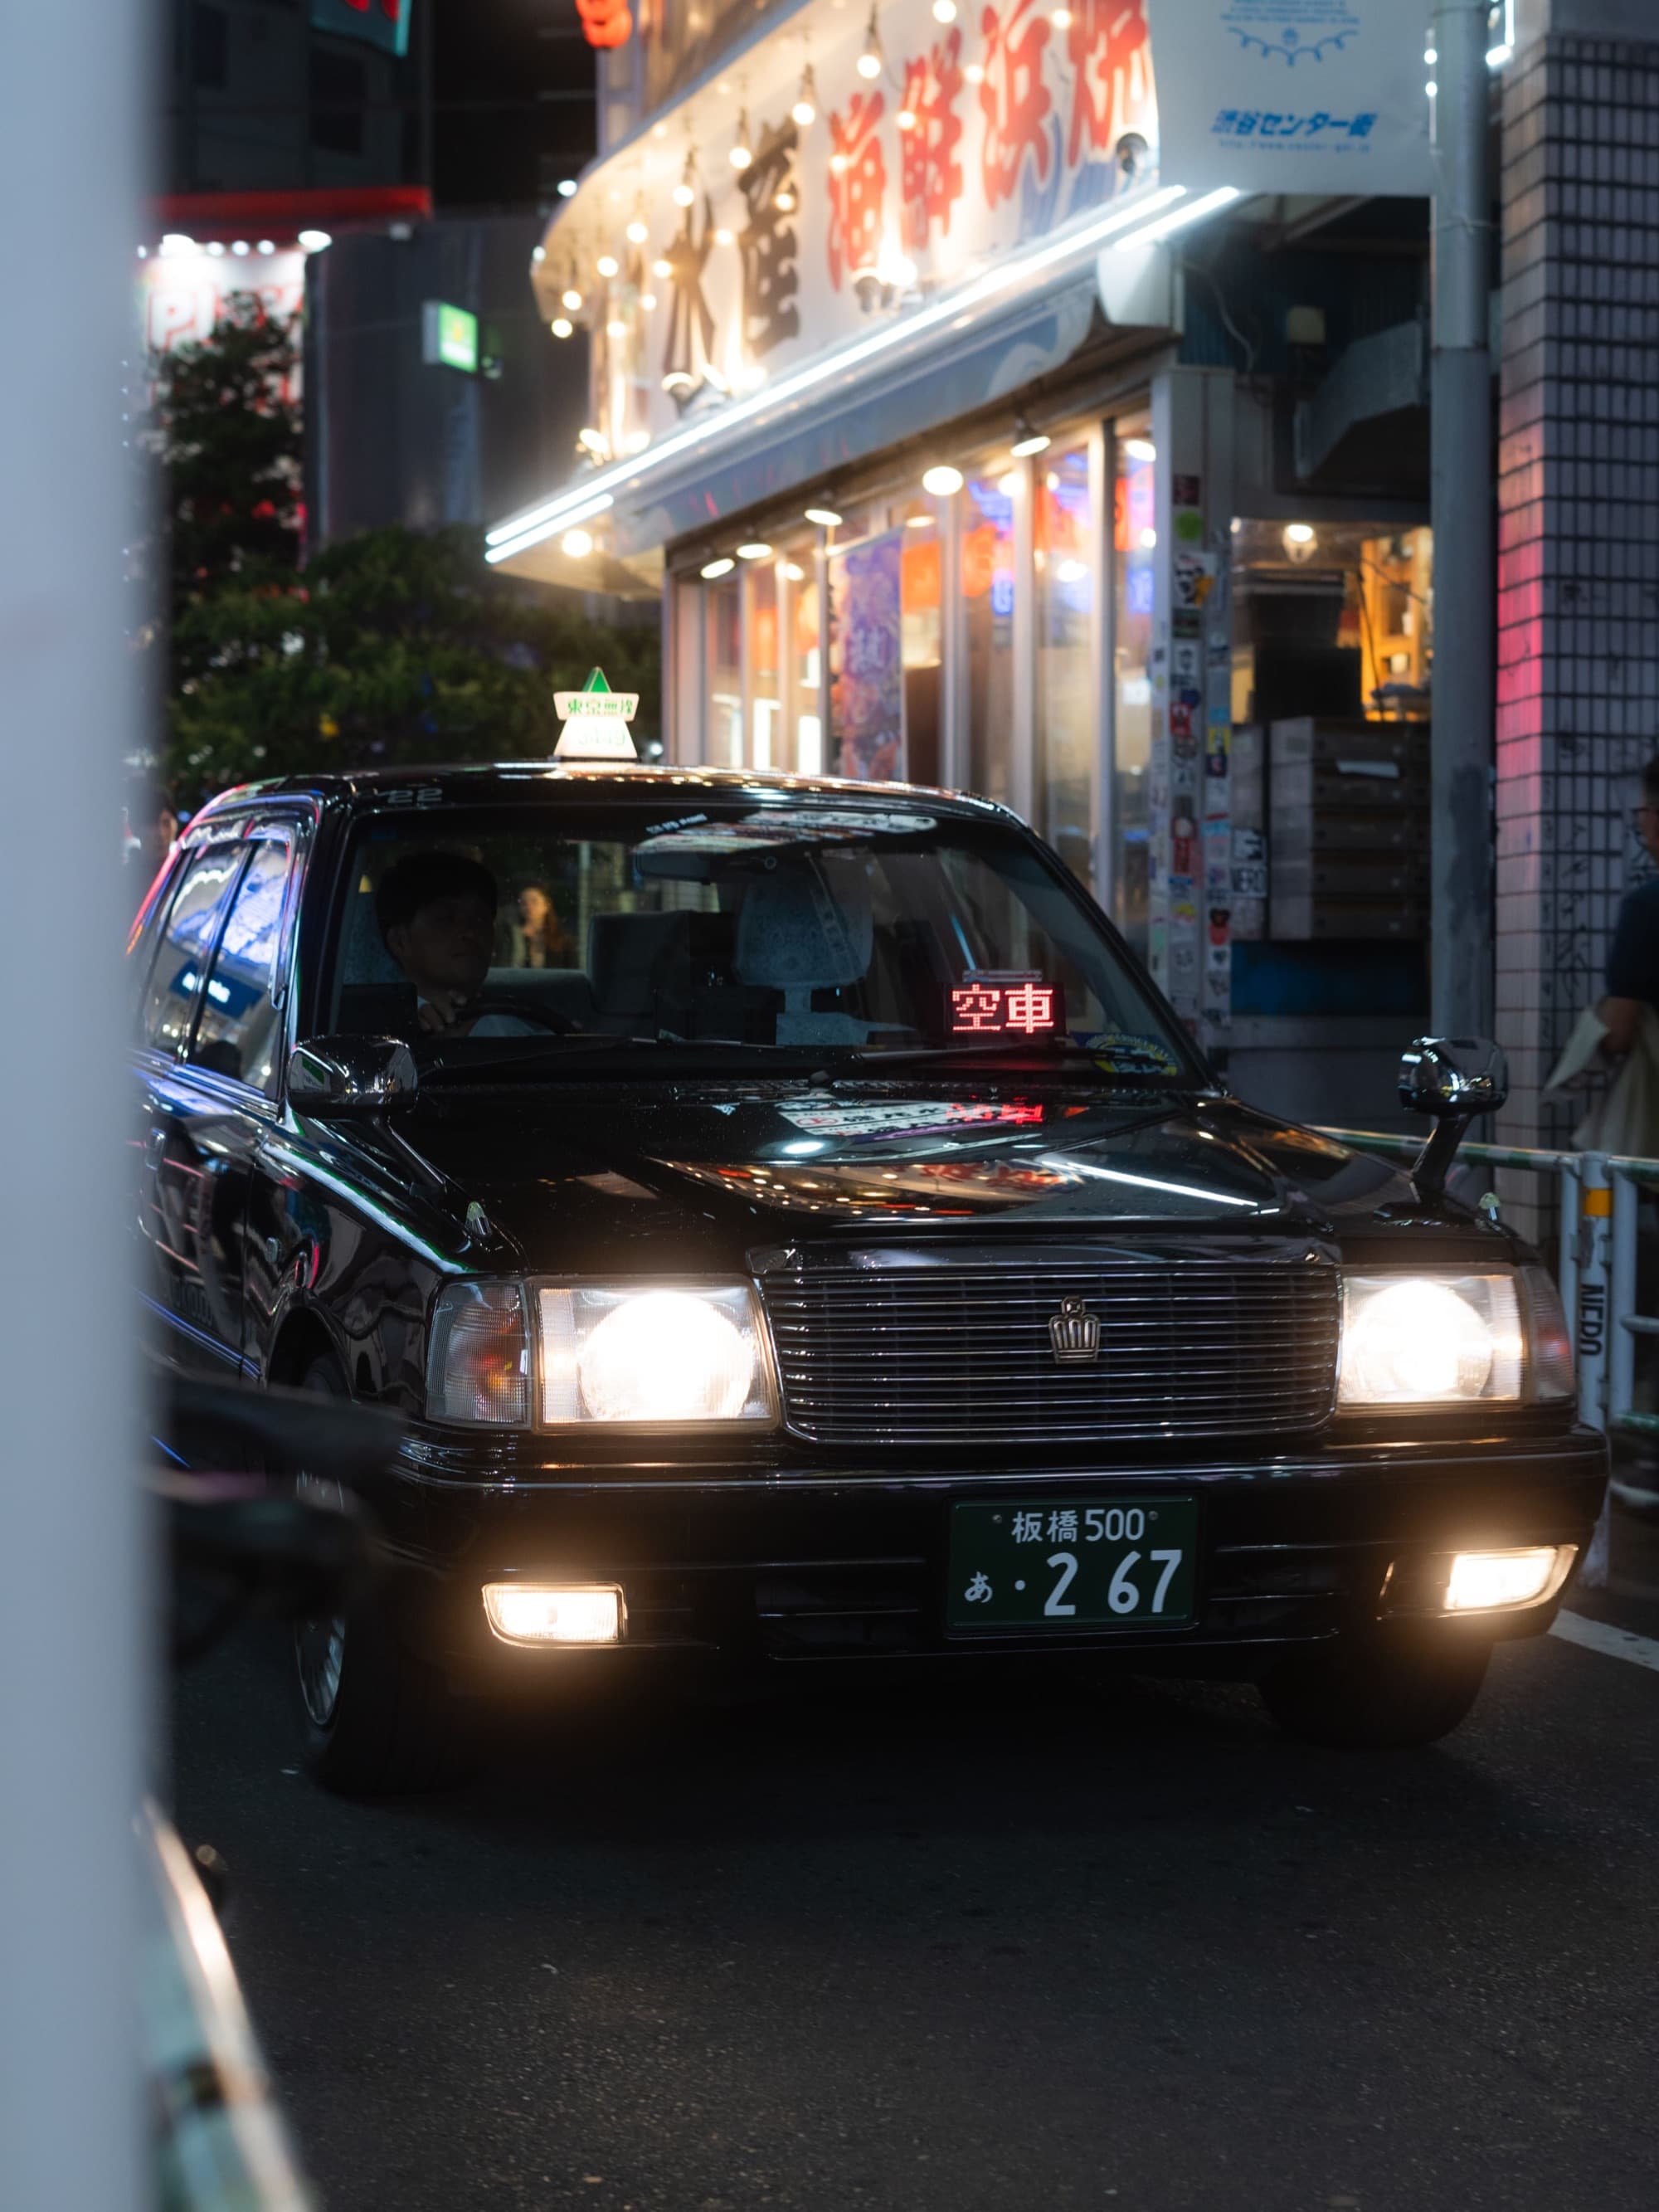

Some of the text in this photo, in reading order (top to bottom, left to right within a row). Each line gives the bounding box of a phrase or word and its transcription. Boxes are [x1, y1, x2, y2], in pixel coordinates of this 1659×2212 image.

[952, 983, 1054, 1034] 空車
[1011, 1508, 1145, 1543] 板橋 500
